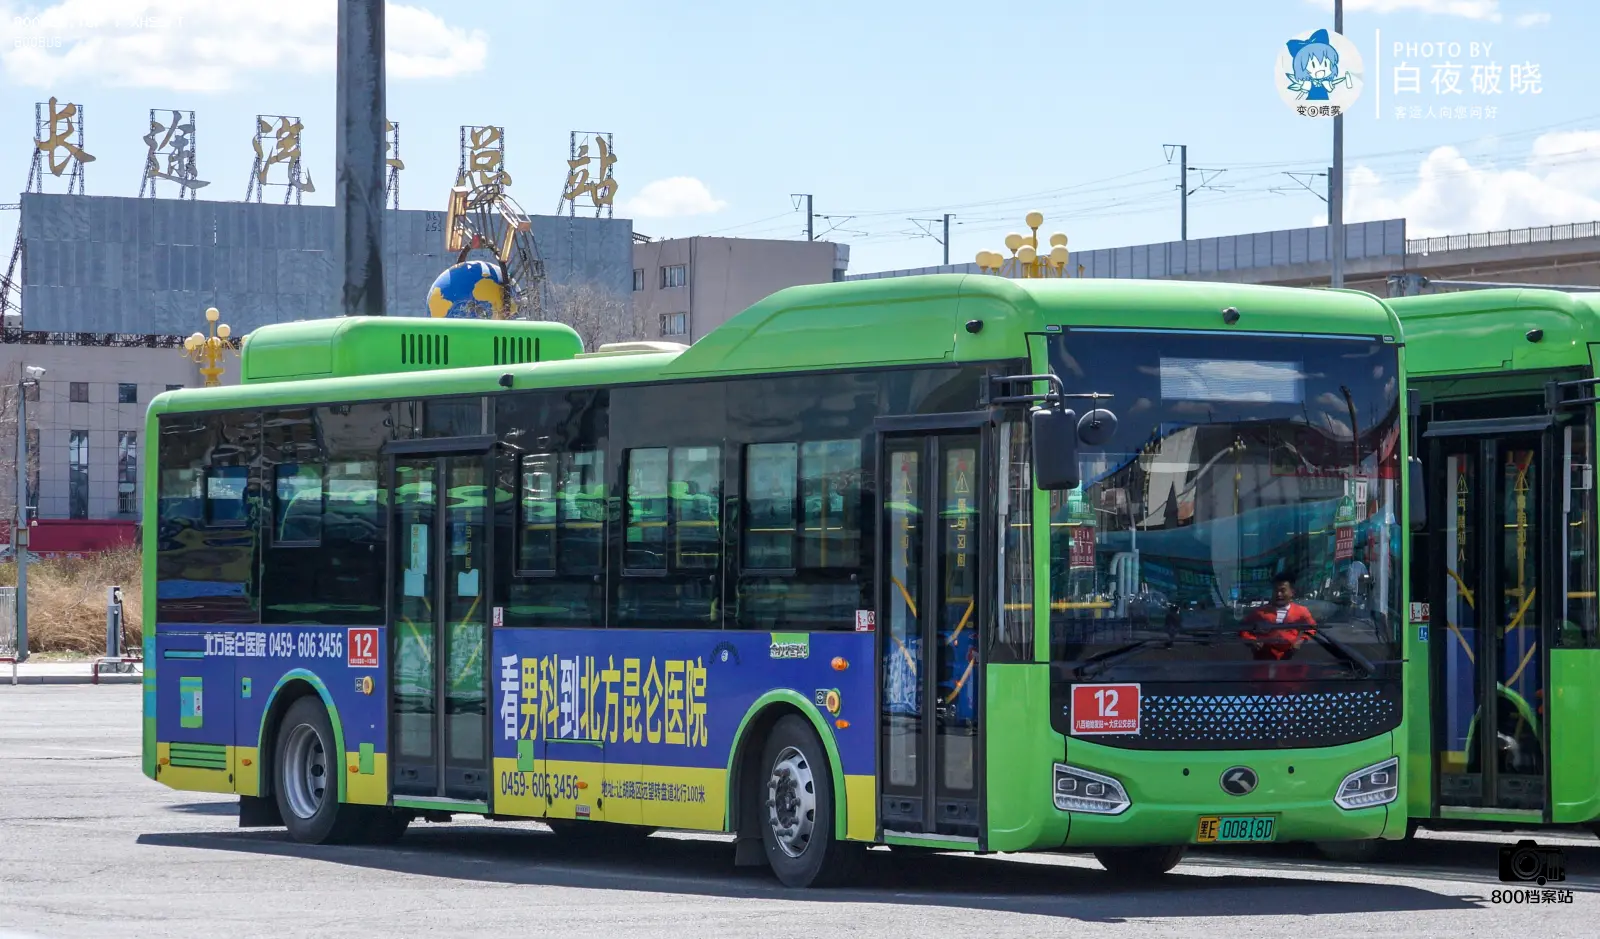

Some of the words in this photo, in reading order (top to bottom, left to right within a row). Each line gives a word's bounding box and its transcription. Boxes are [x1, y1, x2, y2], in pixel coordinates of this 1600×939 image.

[35, 96, 618, 206] 长途汽总站
[204, 632, 266, 657] 北方昆仑医院
[354, 633, 372, 657] 12
[500, 653, 708, 748] 看男科到北方昆仑医院
[1094, 689, 1119, 717] 12
